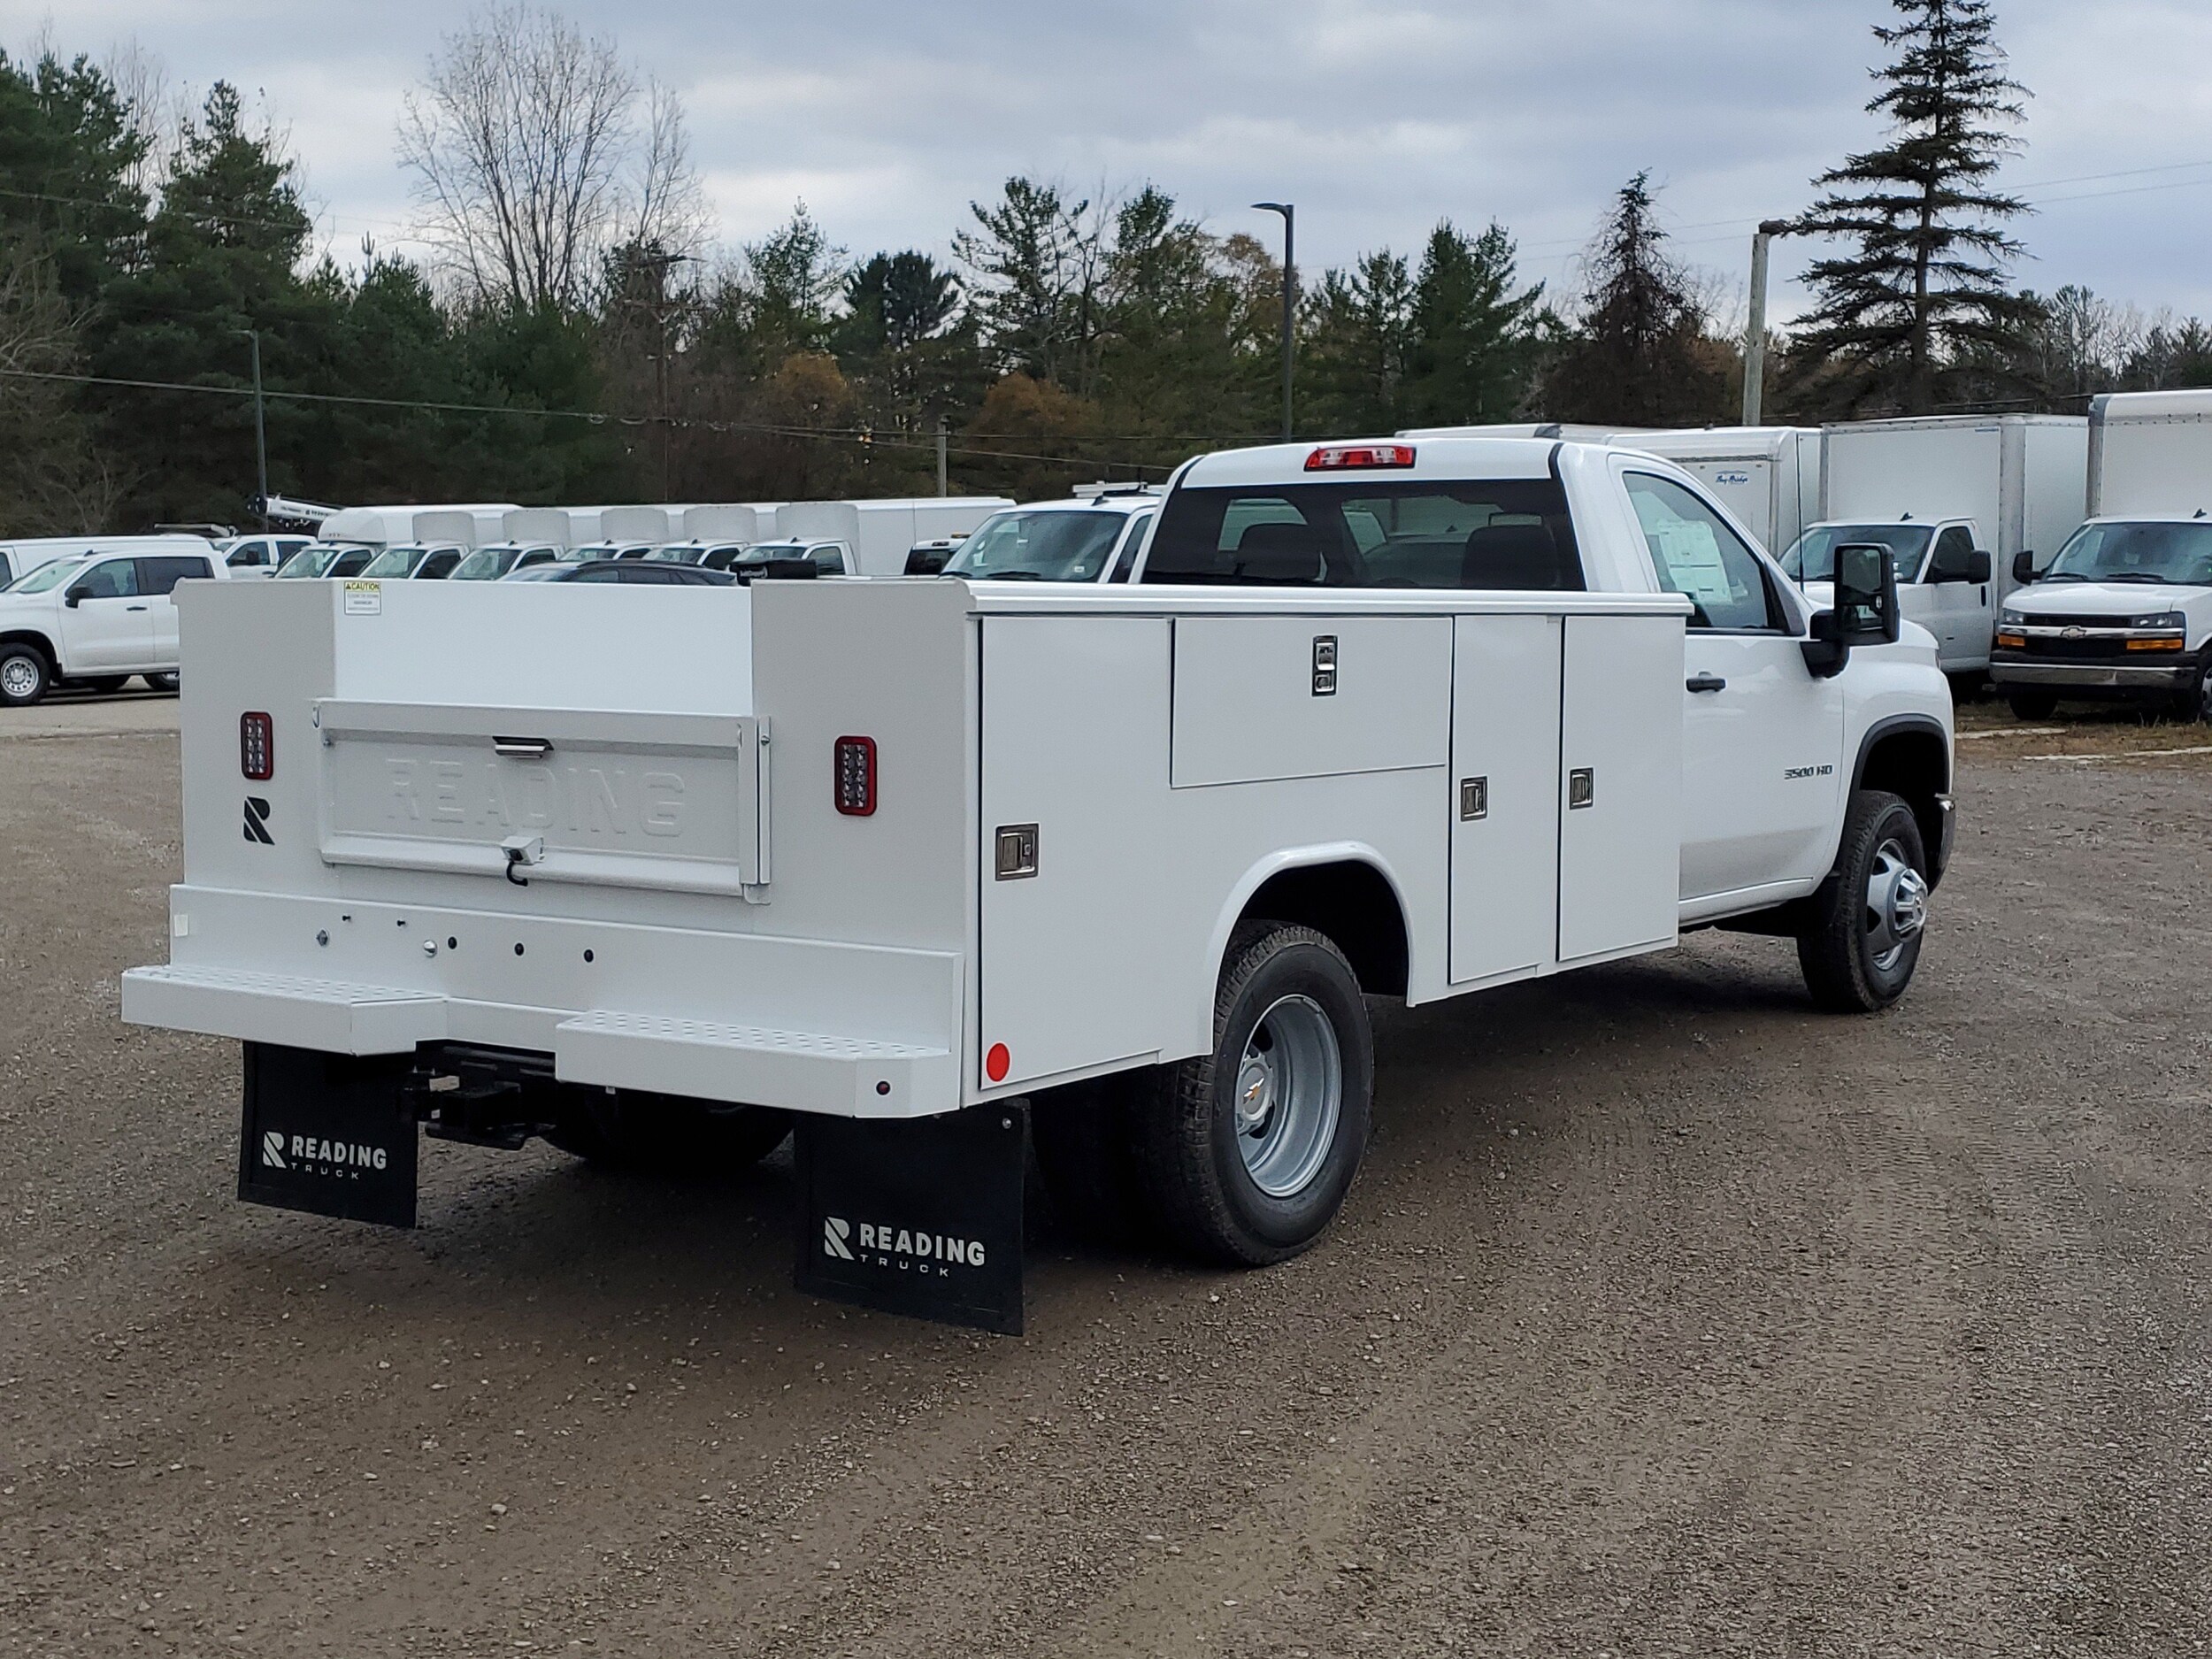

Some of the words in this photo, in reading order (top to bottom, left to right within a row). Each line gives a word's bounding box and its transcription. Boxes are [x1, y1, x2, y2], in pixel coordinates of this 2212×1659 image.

[351, 582, 380, 591] CAUTION
[1784, 766, 1815, 780] 3500
[1816, 764, 1833, 776] HD
[386, 758, 686, 838] READING
[291, 1135, 387, 1170] READING
[290, 1162, 359, 1180] TRUCK
[860, 1223, 985, 1266] READING
[859, 1254, 949, 1278] TRUCK
